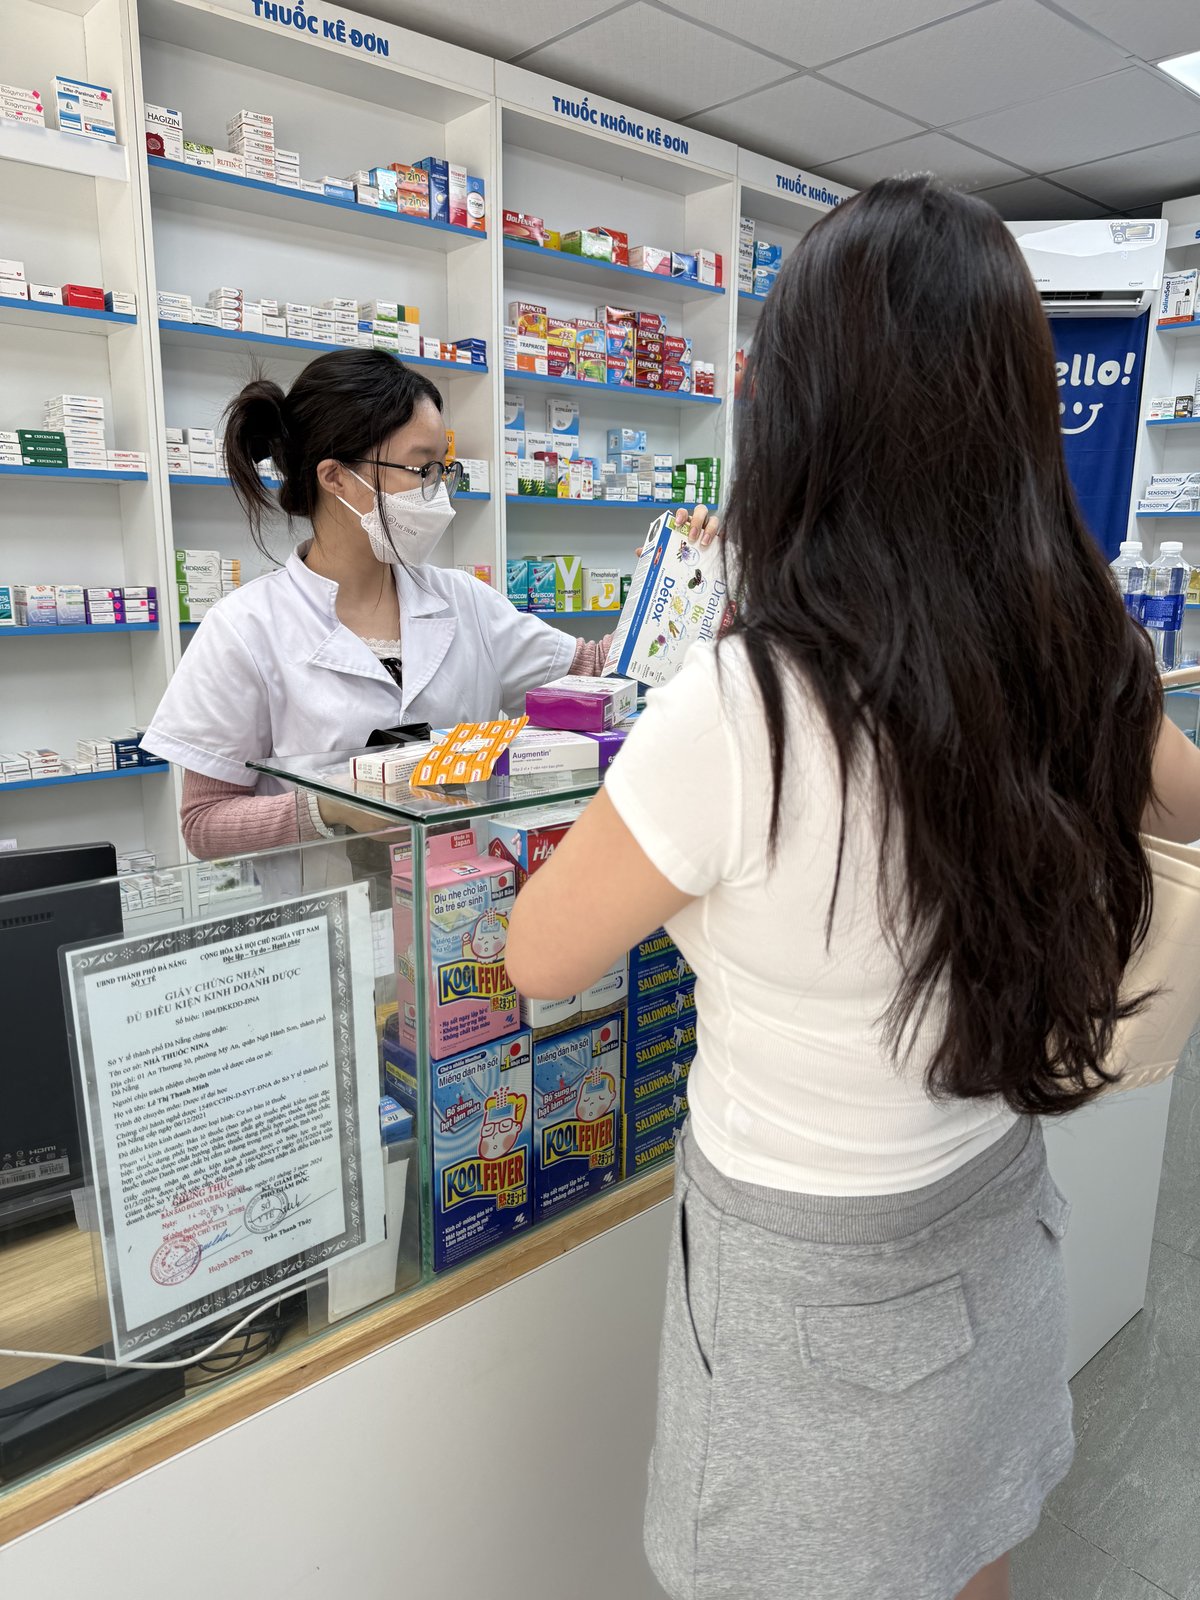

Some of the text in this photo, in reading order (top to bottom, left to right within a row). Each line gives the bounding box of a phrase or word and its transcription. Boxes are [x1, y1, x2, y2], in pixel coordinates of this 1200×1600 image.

[251, 0, 389, 56] THUỐC KÊ ĐƠN
[147, 112, 180, 127] HAGIZIN
[552, 96, 689, 155] THUỐC KHÔNG KÊ ĐƠN
[217, 158, 243, 170] RUTIN-C
[407, 170, 426, 183] zinc
[776, 174, 806, 196] THUỐC
[808, 187, 839, 206] KHÔNG
[1162, 281, 1171, 314] SalineSea
[559, 332, 572, 341] 325
[647, 344, 660, 352] 650
[646, 373, 659, 382] 650
[1055, 352, 1136, 386] ello!
[1153, 476, 1182, 484] SENSODYNE
[1148, 489, 1177, 497] SENSODYNE
[1140, 502, 1169, 510] SENSODYNE
[591, 571, 619, 580] Phosphalugel
[603, 583, 615, 600] P
[651, 576, 676, 623] Détox
[691, 602, 705, 624] Bio
[512, 750, 550, 760] Augmentin
[453, 834, 467, 842] Made
[454, 839, 471, 848] Japan
[434, 893, 447, 905] Dịu
[463, 886, 477, 897] cho
[477, 882, 488, 893] làn
[434, 895, 484, 915] da trẻ sơ sinh
[199, 925, 319, 962] CỘNG HÒA XÃ HỘI CHỦ NGHĨA VIỆT NAM
[222, 955, 234, 964] Độc
[234, 952, 244, 961] lập
[249, 949, 258, 957] Tự
[271, 941, 287, 951] Hạnh
[287, 937, 301, 947] phúc
[95, 958, 187, 988] UBND THÀNH PHỐ ĐÀ NẴNG
[147, 975, 157, 983] TẾ
[163, 966, 265, 1001] GIẤY CHỨNG NHẬN
[638, 968, 679, 992] SALONPAS
[125, 966, 302, 1024] ĐỦ ĐIỀU KIỆN KINH DOANH DƯỢC
[174, 1016, 184, 1025] Số
[184, 1012, 200, 1023] hiệu:
[637, 1002, 678, 1027] SALONPAS
[107, 1059, 117, 1067] Sở
[124, 1053, 131, 1061] tế
[132, 1048, 150, 1059] thành
[150, 1043, 164, 1054] phố
[164, 1041, 174, 1049] Đà
[174, 1035, 191, 1047] Nẵng
[191, 1030, 211, 1042] chứng
[211, 1025, 229, 1036] nhận:
[109, 1080, 122, 1089] Địa
[122, 1075, 136, 1085] chỉ:
[146, 1069, 157, 1077] An
[157, 1061, 182, 1075] Thượng
[182, 1058, 193, 1066] 30,
[193, 1050, 217, 1064] phường
[217, 1046, 229, 1056] Mỹ
[229, 1042, 240, 1051] An,
[241, 1038, 256, 1048] quận
[256, 1033, 269, 1043] Ngũ
[269, 1028, 285, 1038] Hành
[285, 1024, 299, 1033] Sơn,
[299, 1018, 315, 1028] thành
[315, 1014, 327, 1024] phố
[537, 1037, 590, 1064] Miếng dán hạ sốt
[635, 1036, 677, 1063] SALONPAS
[108, 1069, 122, 1078] Tên
[122, 1066, 131, 1074] cơ
[142, 1055, 161, 1067] NHÀ
[160, 1046, 189, 1061] THUỐC
[189, 1041, 209, 1052] NINA
[439, 1072, 462, 1087] Miếng
[462, 1067, 476, 1078] dán
[477, 1062, 487, 1073] hạ
[487, 1056, 499, 1068] sốt
[110, 1082, 139, 1097] Đà Nẵng
[634, 1073, 675, 1099] SALONPAS
[113, 1111, 124, 1120] Họ
[133, 1104, 146, 1112] tên:
[156, 1096, 169, 1105] Thị
[169, 1088, 191, 1100] Thanh
[191, 1082, 209, 1092] Minh
[446, 1099, 473, 1117] Bổ sung
[441, 1103, 481, 1133] hạt làm mát
[635, 1105, 675, 1132] SALONPAS
[635, 1139, 674, 1166] SALONPAS
